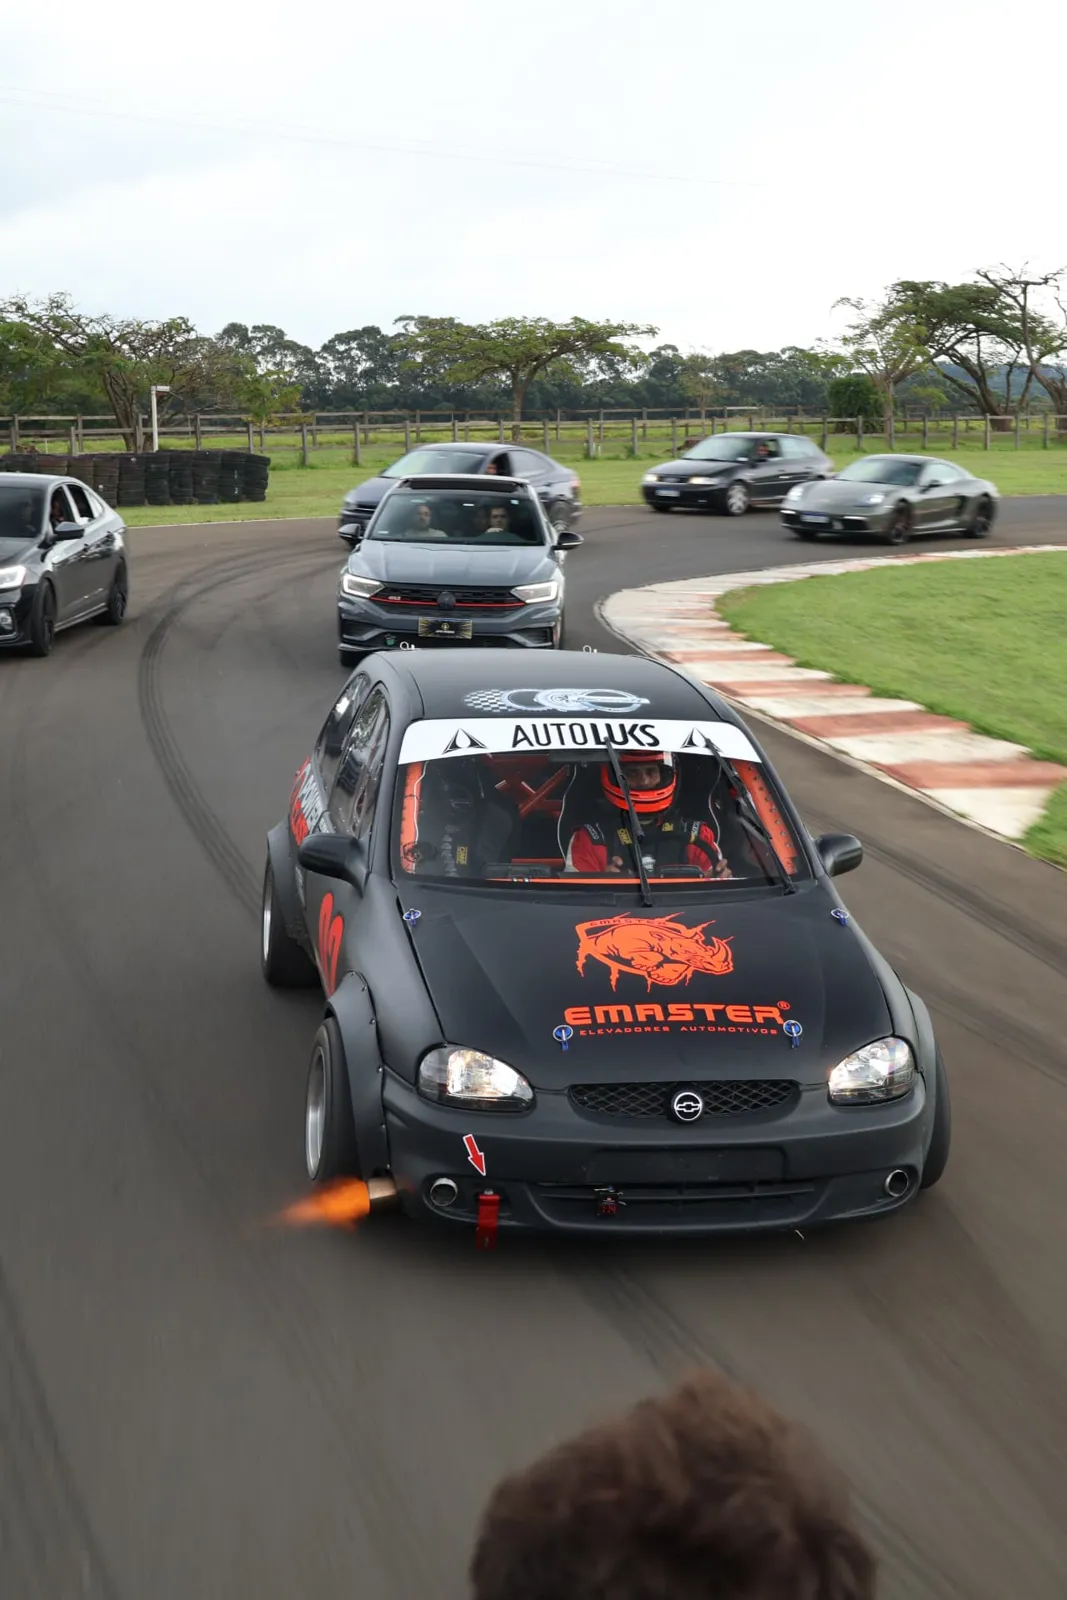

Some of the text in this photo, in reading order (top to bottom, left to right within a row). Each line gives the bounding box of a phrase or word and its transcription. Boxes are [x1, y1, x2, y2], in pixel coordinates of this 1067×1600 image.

[511, 722, 660, 748] AUTOLUKS
[589, 918, 667, 927] EMASTER
[579, 1025, 778, 1036] ELEVADORES AUTOMOTIVOS
